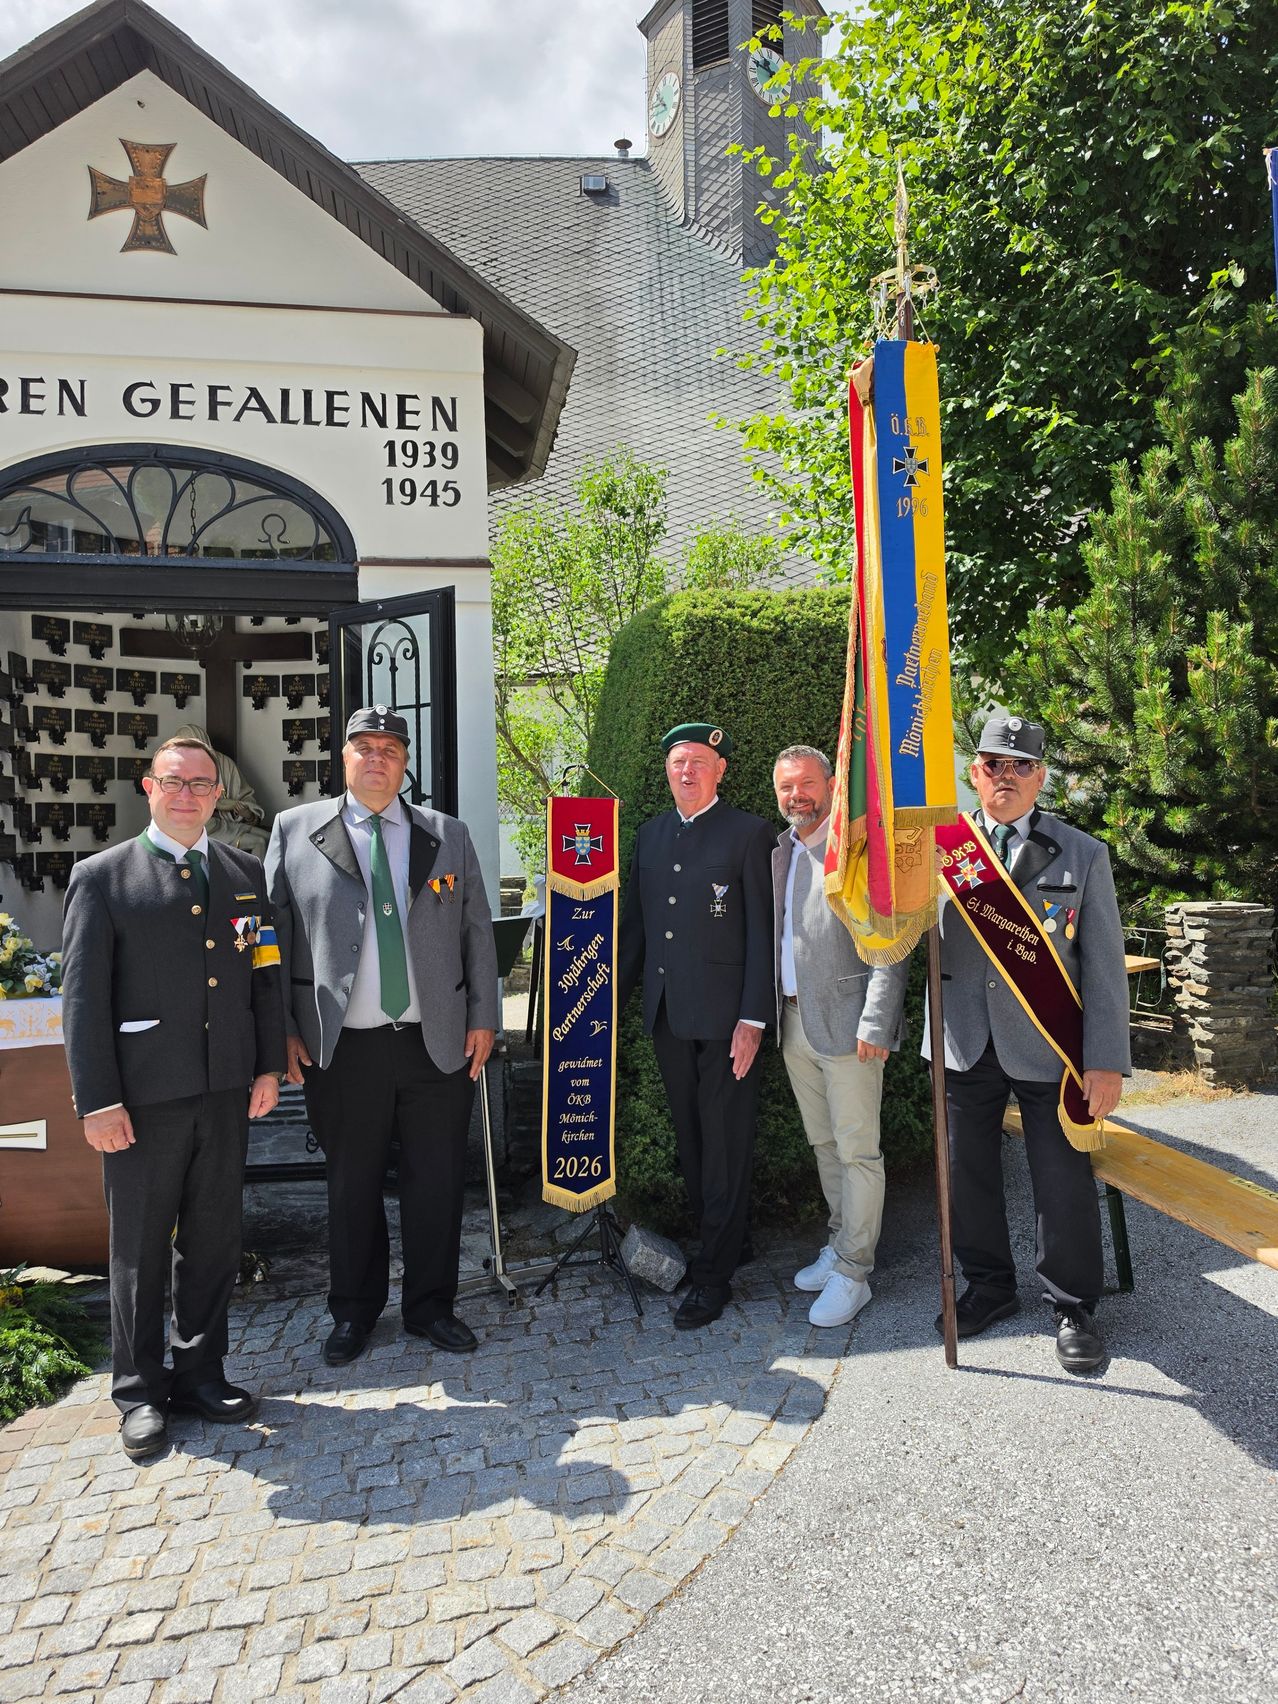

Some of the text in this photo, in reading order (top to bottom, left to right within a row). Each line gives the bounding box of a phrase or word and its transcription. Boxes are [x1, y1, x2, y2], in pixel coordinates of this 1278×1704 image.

[122, 381, 458, 432] GEFALLENEN
[383, 439, 459, 470] 1939
[381, 477, 462, 507] 1945
[896, 497, 928, 518] 1996
[896, 569, 939, 689] Partnerverband
[898, 647, 943, 758] Mönichkirchen
[571, 907, 595, 920] Zur
[967, 897, 1040, 946] St. Margarethen
[558, 932, 605, 994] 30jährigen
[1006, 939, 1038, 965] i. Bgld.
[552, 962, 610, 1042] Partnerschaft
[558, 1056, 603, 1073] gewidmet
[570, 1078, 590, 1087] vom
[567, 1093, 592, 1106] ÖKB
[559, 1112, 598, 1124] Mönich-
[561, 1131, 595, 1144] kirchen
[554, 1155, 603, 1179] 2026
